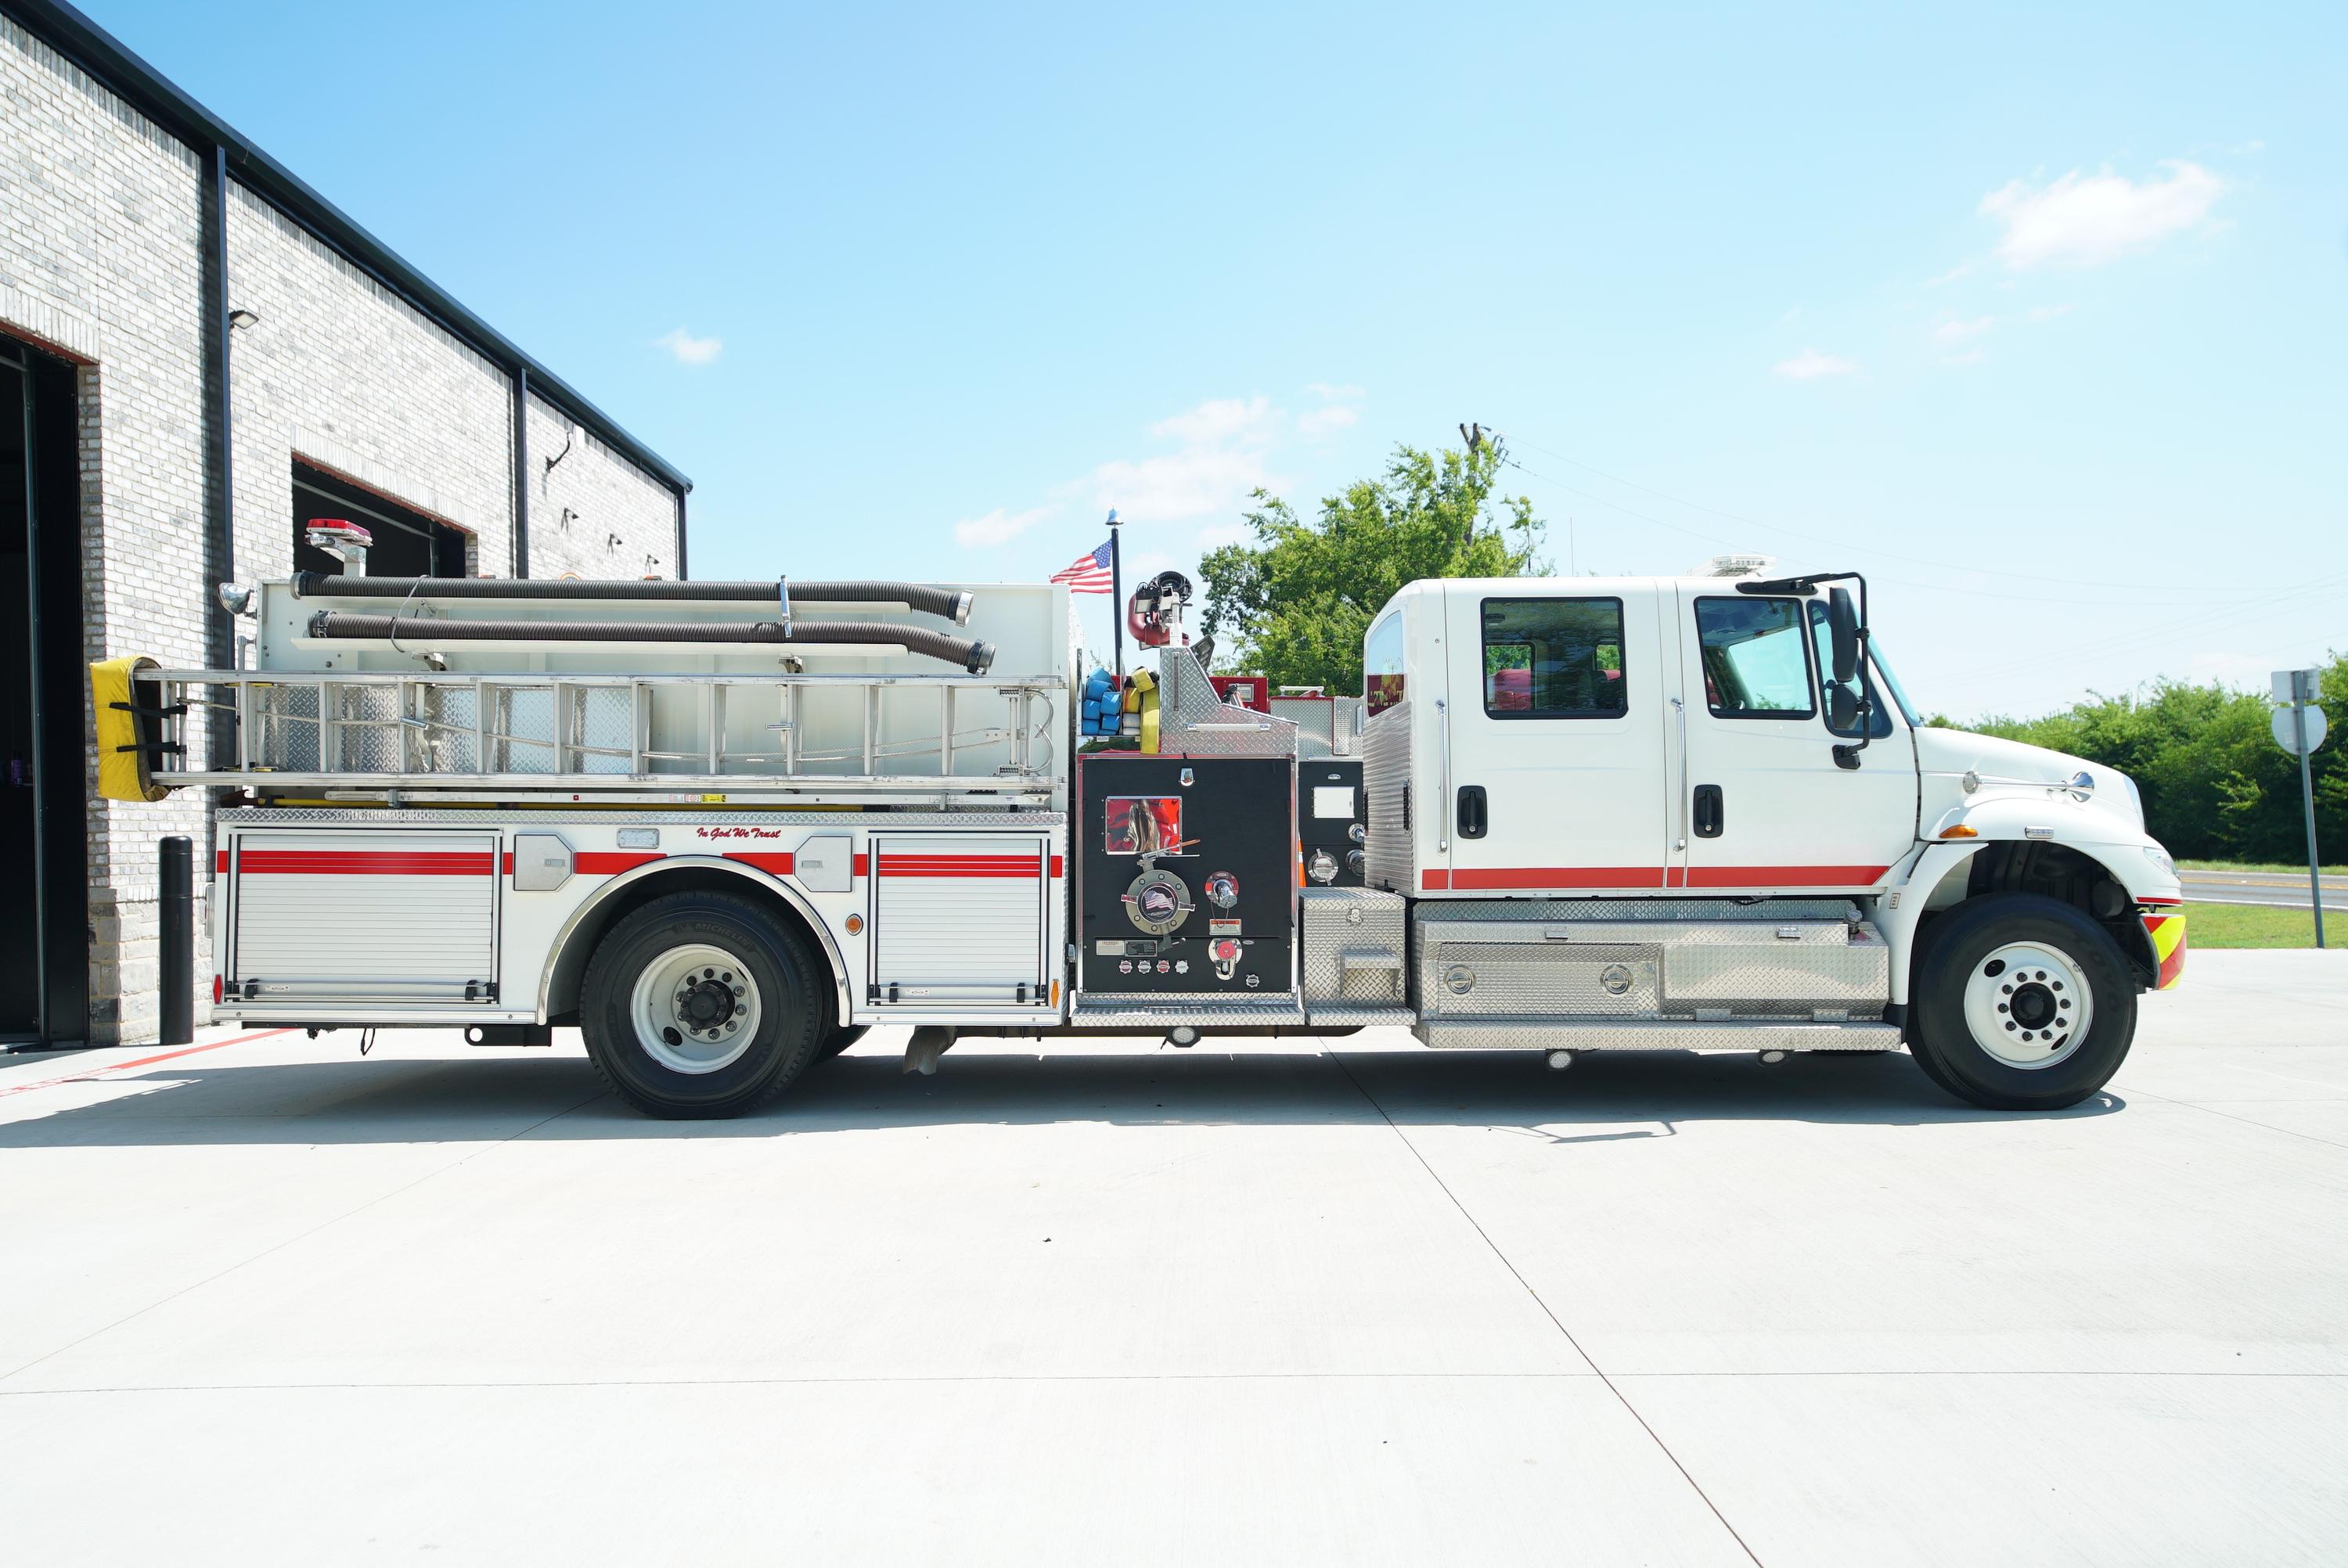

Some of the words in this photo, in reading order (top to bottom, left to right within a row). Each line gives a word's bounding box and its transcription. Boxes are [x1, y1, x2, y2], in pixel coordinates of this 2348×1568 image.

[697, 827, 708, 837] In
[710, 827, 732, 841] God
[733, 827, 750, 839] We
[751, 827, 781, 839] Trust
[694, 922, 752, 948] MICHELIN
